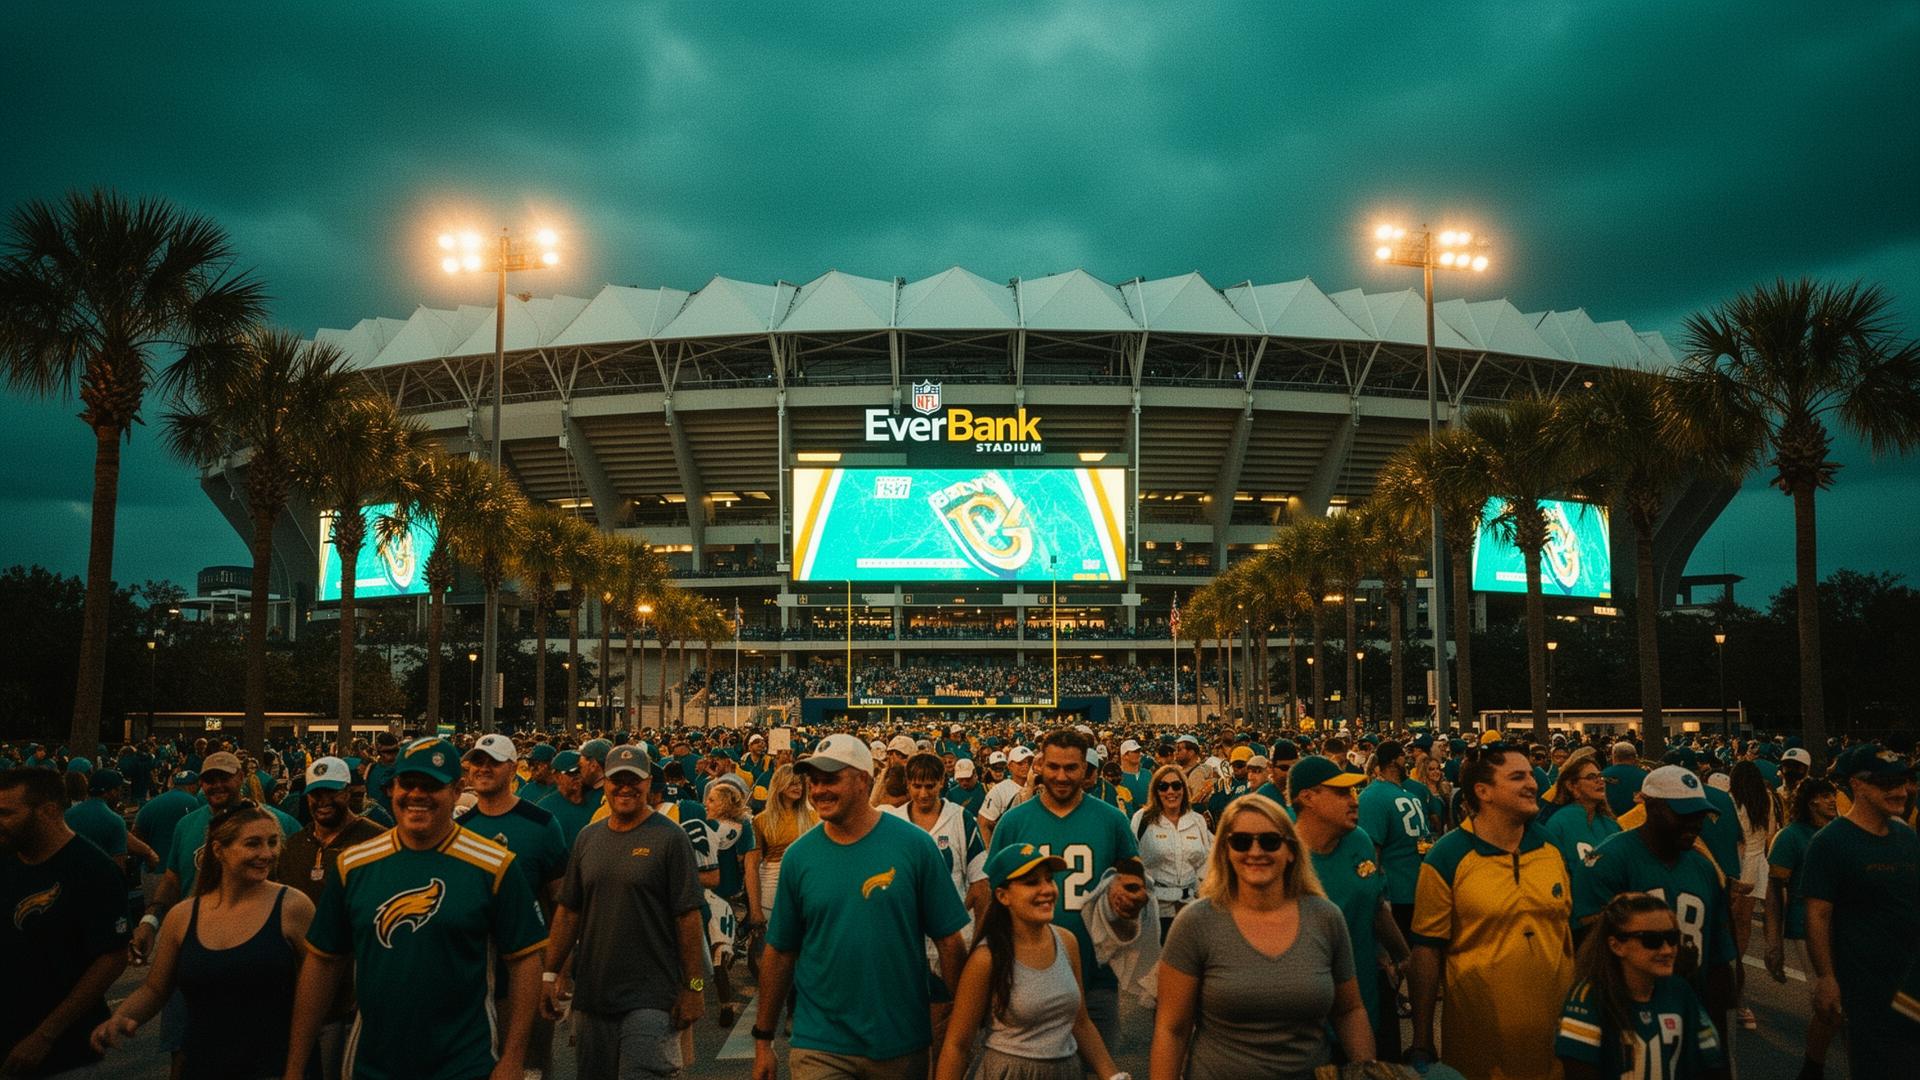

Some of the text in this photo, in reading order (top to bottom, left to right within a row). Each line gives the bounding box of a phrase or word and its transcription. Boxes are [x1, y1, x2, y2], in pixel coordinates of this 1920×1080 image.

[917, 395, 938, 408] NFL
[865, 408, 1042, 442] EverBank
[976, 443, 1042, 452] STADIUM
[1038, 843, 1093, 911] 2
[1646, 887, 1706, 968] 8
